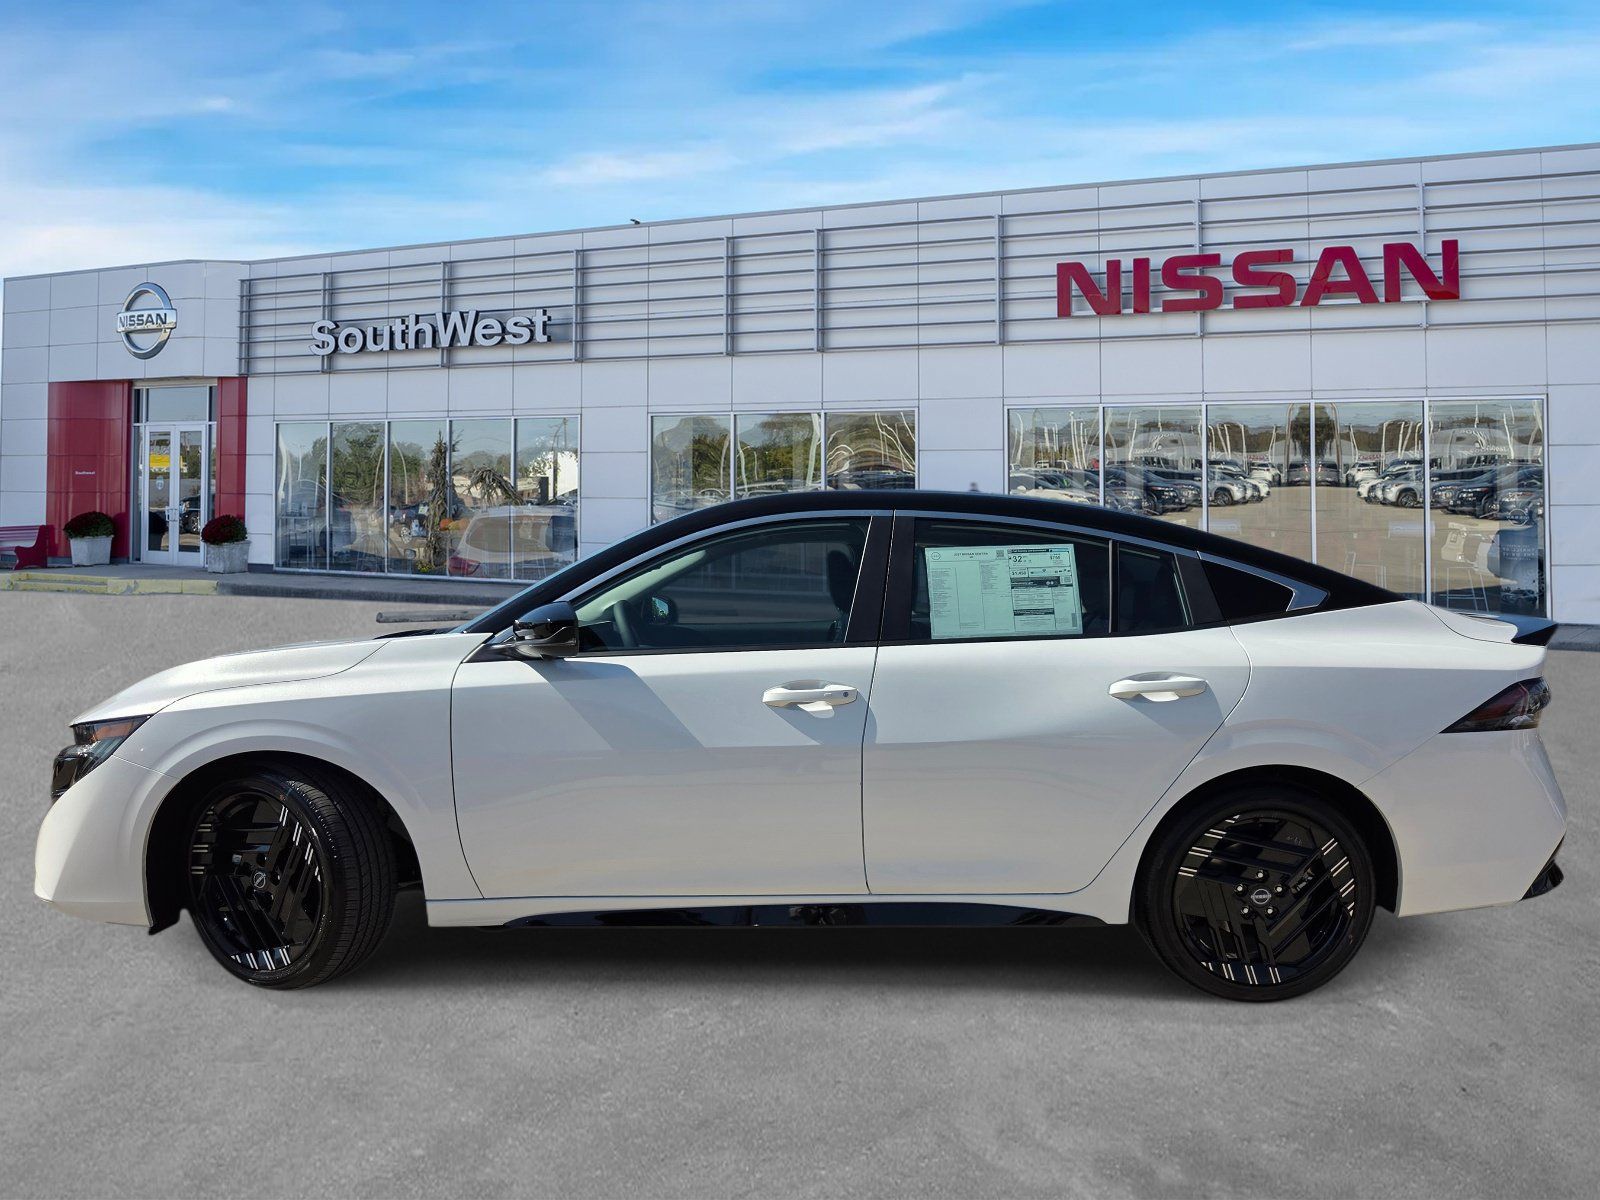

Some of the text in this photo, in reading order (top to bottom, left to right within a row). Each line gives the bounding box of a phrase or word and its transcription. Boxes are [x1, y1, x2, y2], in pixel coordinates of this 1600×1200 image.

[1057, 239, 1460, 318] NISSAN
[119, 312, 168, 328] NISSAN
[308, 308, 551, 356] SouthWest
[1012, 555, 1023, 563] 32
